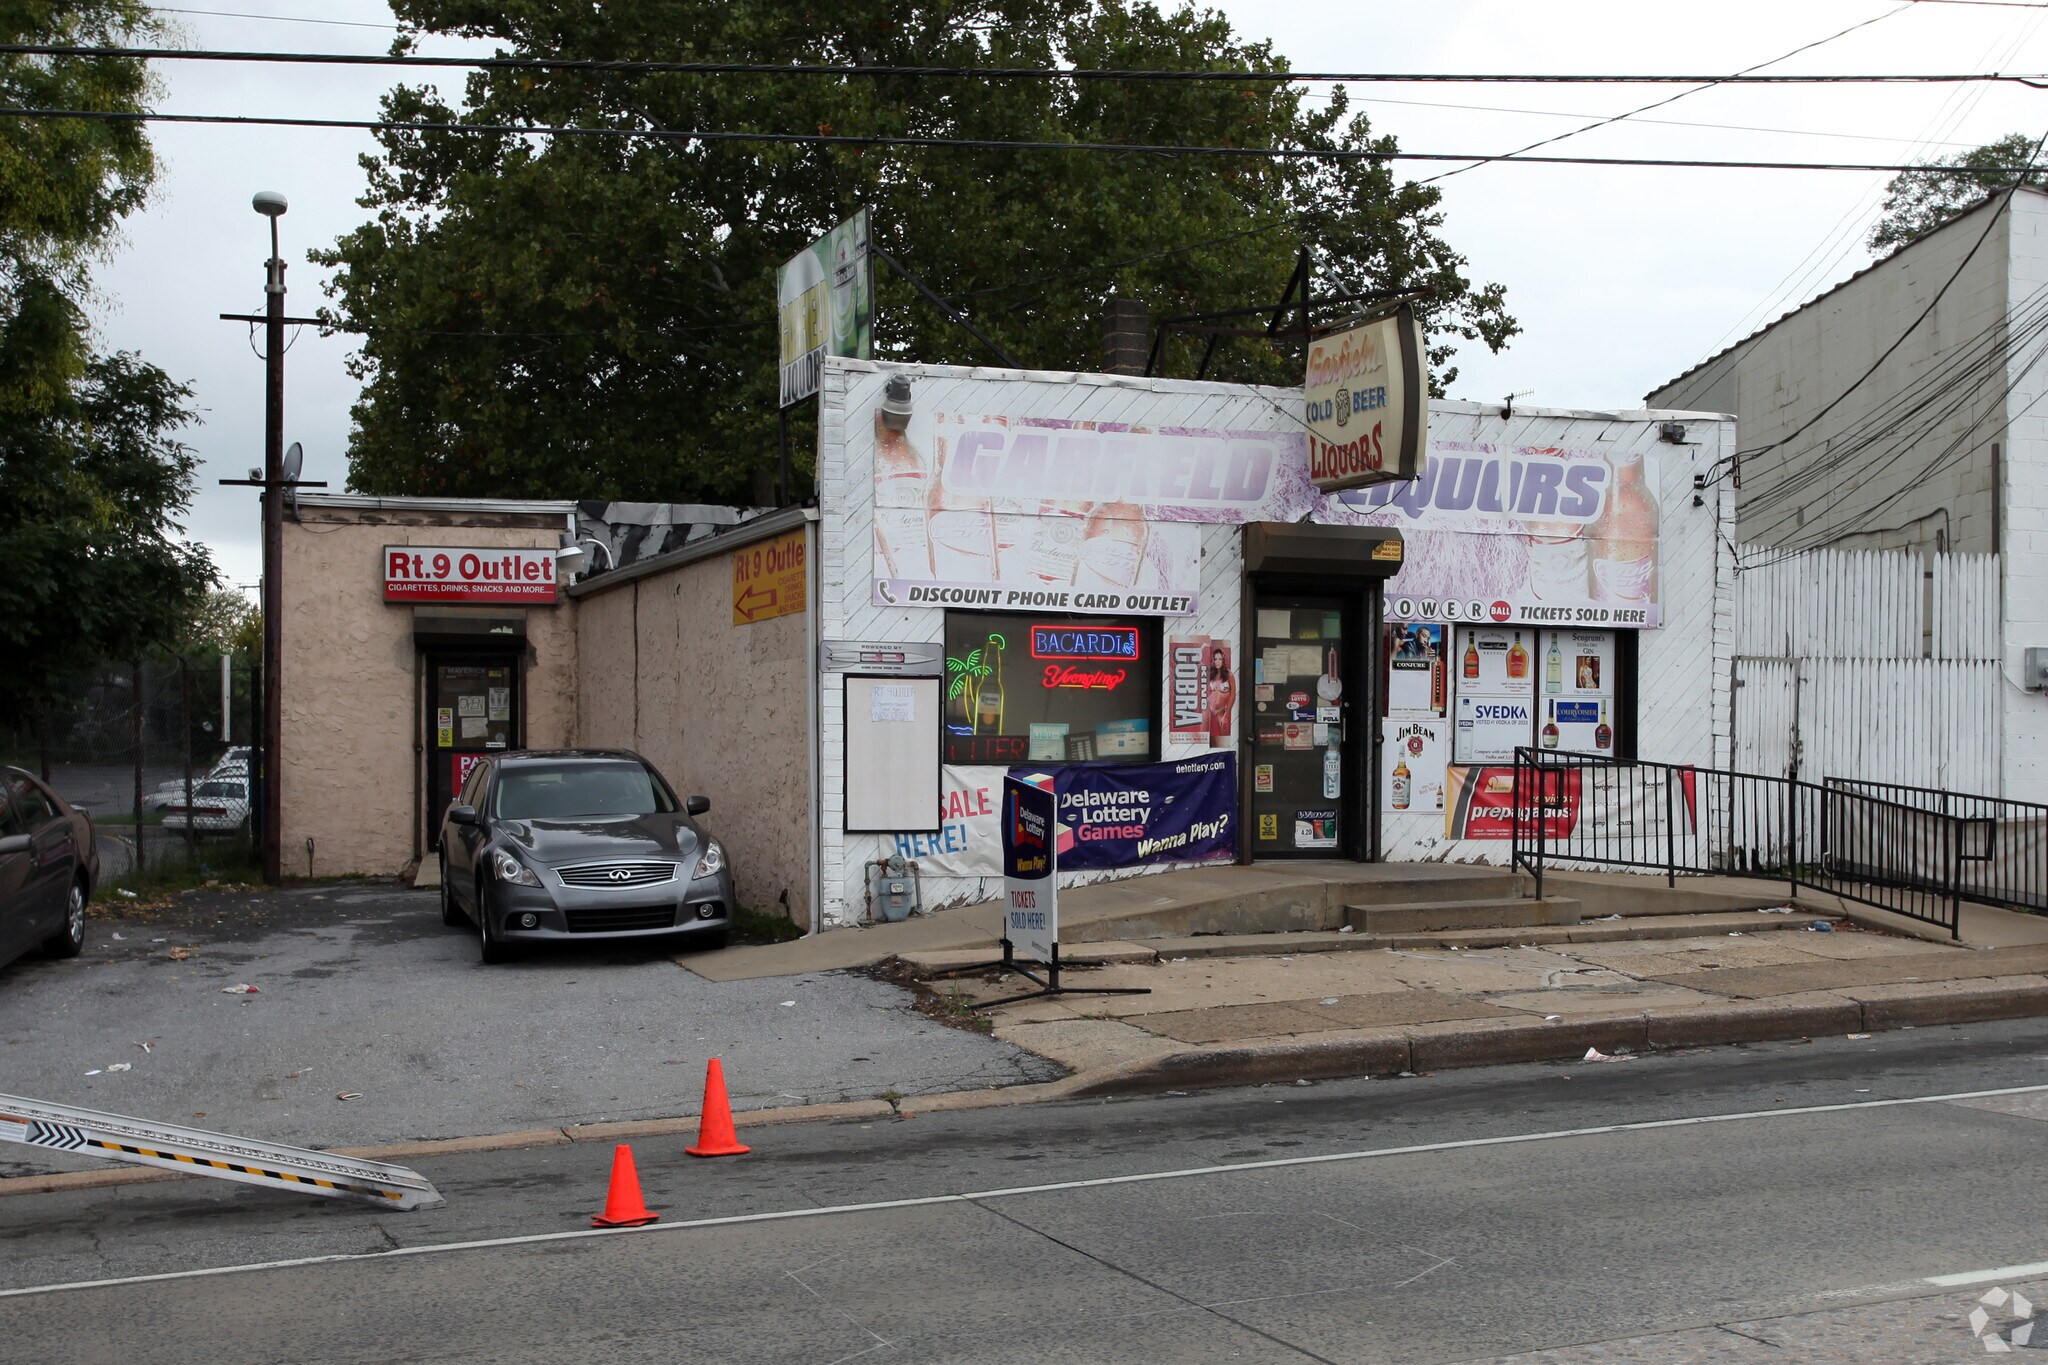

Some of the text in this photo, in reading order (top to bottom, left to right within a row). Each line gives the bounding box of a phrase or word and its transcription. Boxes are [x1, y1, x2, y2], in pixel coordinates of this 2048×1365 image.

[1308, 333, 1382, 387] Garfield
[1306, 386, 1387, 424] COLD BEER
[1310, 420, 1383, 480] LIQUORS
[949, 430, 1274, 501] GARFIELD
[389, 552, 553, 580] Rt.9 Outlet
[735, 555, 750, 583] Rt
[753, 550, 762, 578] 9
[388, 583, 440, 593] CIGARETTES,
[441, 584, 471, 593] DRINKS,
[472, 585, 503, 593] SNACKS
[505, 585, 522, 593] AND
[909, 587, 1190, 612] DISCOUNT PHONE CARD OUTLET
[1490, 606, 1511, 615] BALL
[1519, 606, 1646, 623] TICKETS SOLD HERE
[1036, 632, 1121, 654] BACARDI
[1572, 633, 1605, 643] Seagram's
[1042, 664, 1126, 690] Yuengling
[1174, 647, 1203, 728] COBRA
[1200, 665, 1208, 710] KING
[460, 698, 483, 711] OPEN
[1475, 705, 1528, 719] SVEDKA
[1396, 723, 1435, 742] JIM BEAM
[460, 757, 487, 769] PA
[1175, 761, 1226, 775] delottery.com
[1060, 788, 1150, 808] Delaware
[1019, 806, 1045, 827] Delaware
[1082, 806, 1151, 825] Lottery
[1025, 820, 1045, 841] Lottery
[1077, 824, 1144, 841] Games
[1136, 814, 1229, 858] Wanna Play?
[893, 824, 968, 860] HERE!
[1016, 854, 1047, 872] Wanna Play?
[1011, 891, 1036, 909] TICKETS
[1010, 912, 1046, 930] SOLD HERE!
